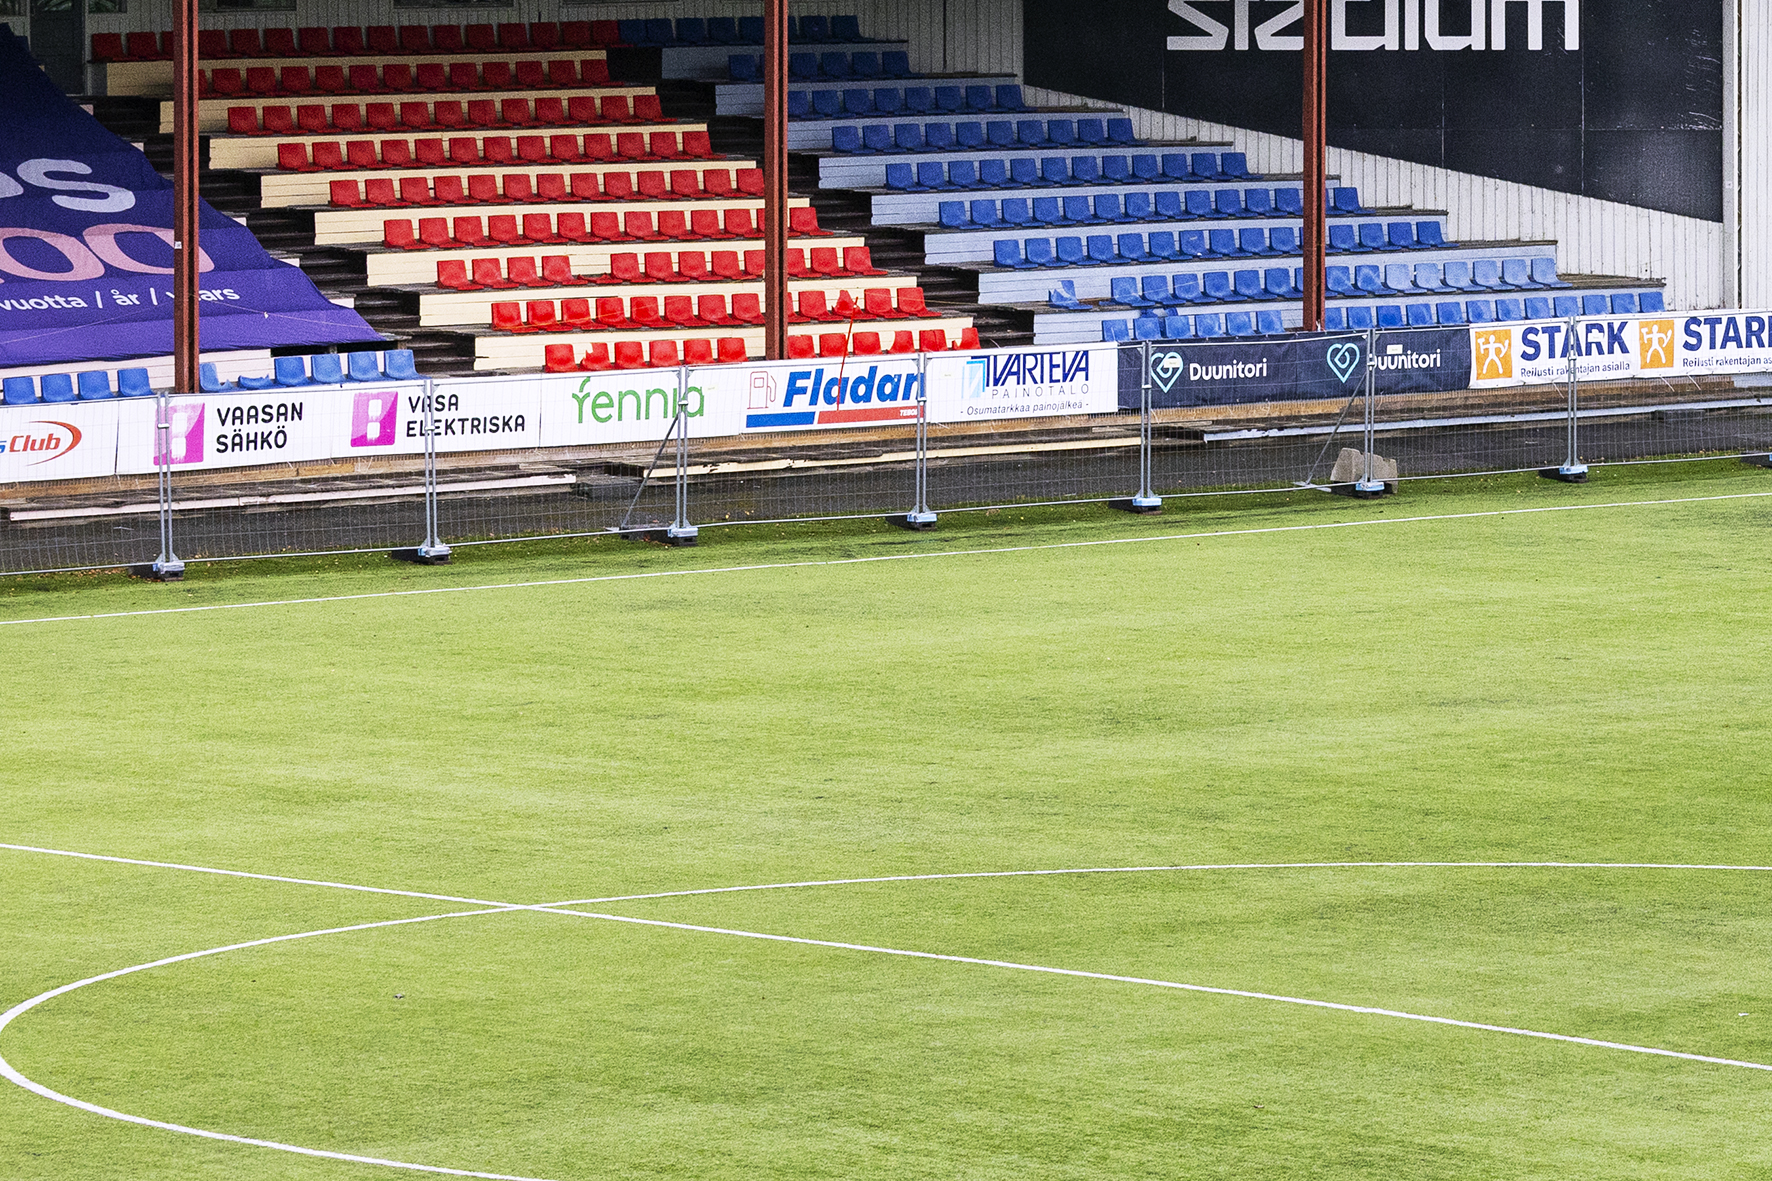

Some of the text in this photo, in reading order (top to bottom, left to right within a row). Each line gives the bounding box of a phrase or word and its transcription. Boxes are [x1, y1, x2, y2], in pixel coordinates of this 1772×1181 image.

[0, 294, 88, 311] vuotta
[110, 289, 141, 307] år
[165, 288, 240, 302] ars
[1520, 321, 1630, 361] STARK
[993, 350, 1089, 387] VARTEVA
[1189, 358, 1267, 381] Duunitori
[1520, 366, 1554, 378] Reilusti
[1602, 360, 1630, 372] asialla
[1682, 356, 1714, 367] Reilusti
[1715, 355, 1761, 368] rakentajan
[783, 365, 925, 408] Fladan
[992, 383, 1089, 399] PAINOTALO
[216, 402, 303, 427] VAASAN
[408, 394, 459, 413] VASA
[966, 403, 1030, 416] Osumatarkkaa
[406, 414, 526, 437] ELEKTRISKA
[216, 425, 287, 454] SÄHKÖ
